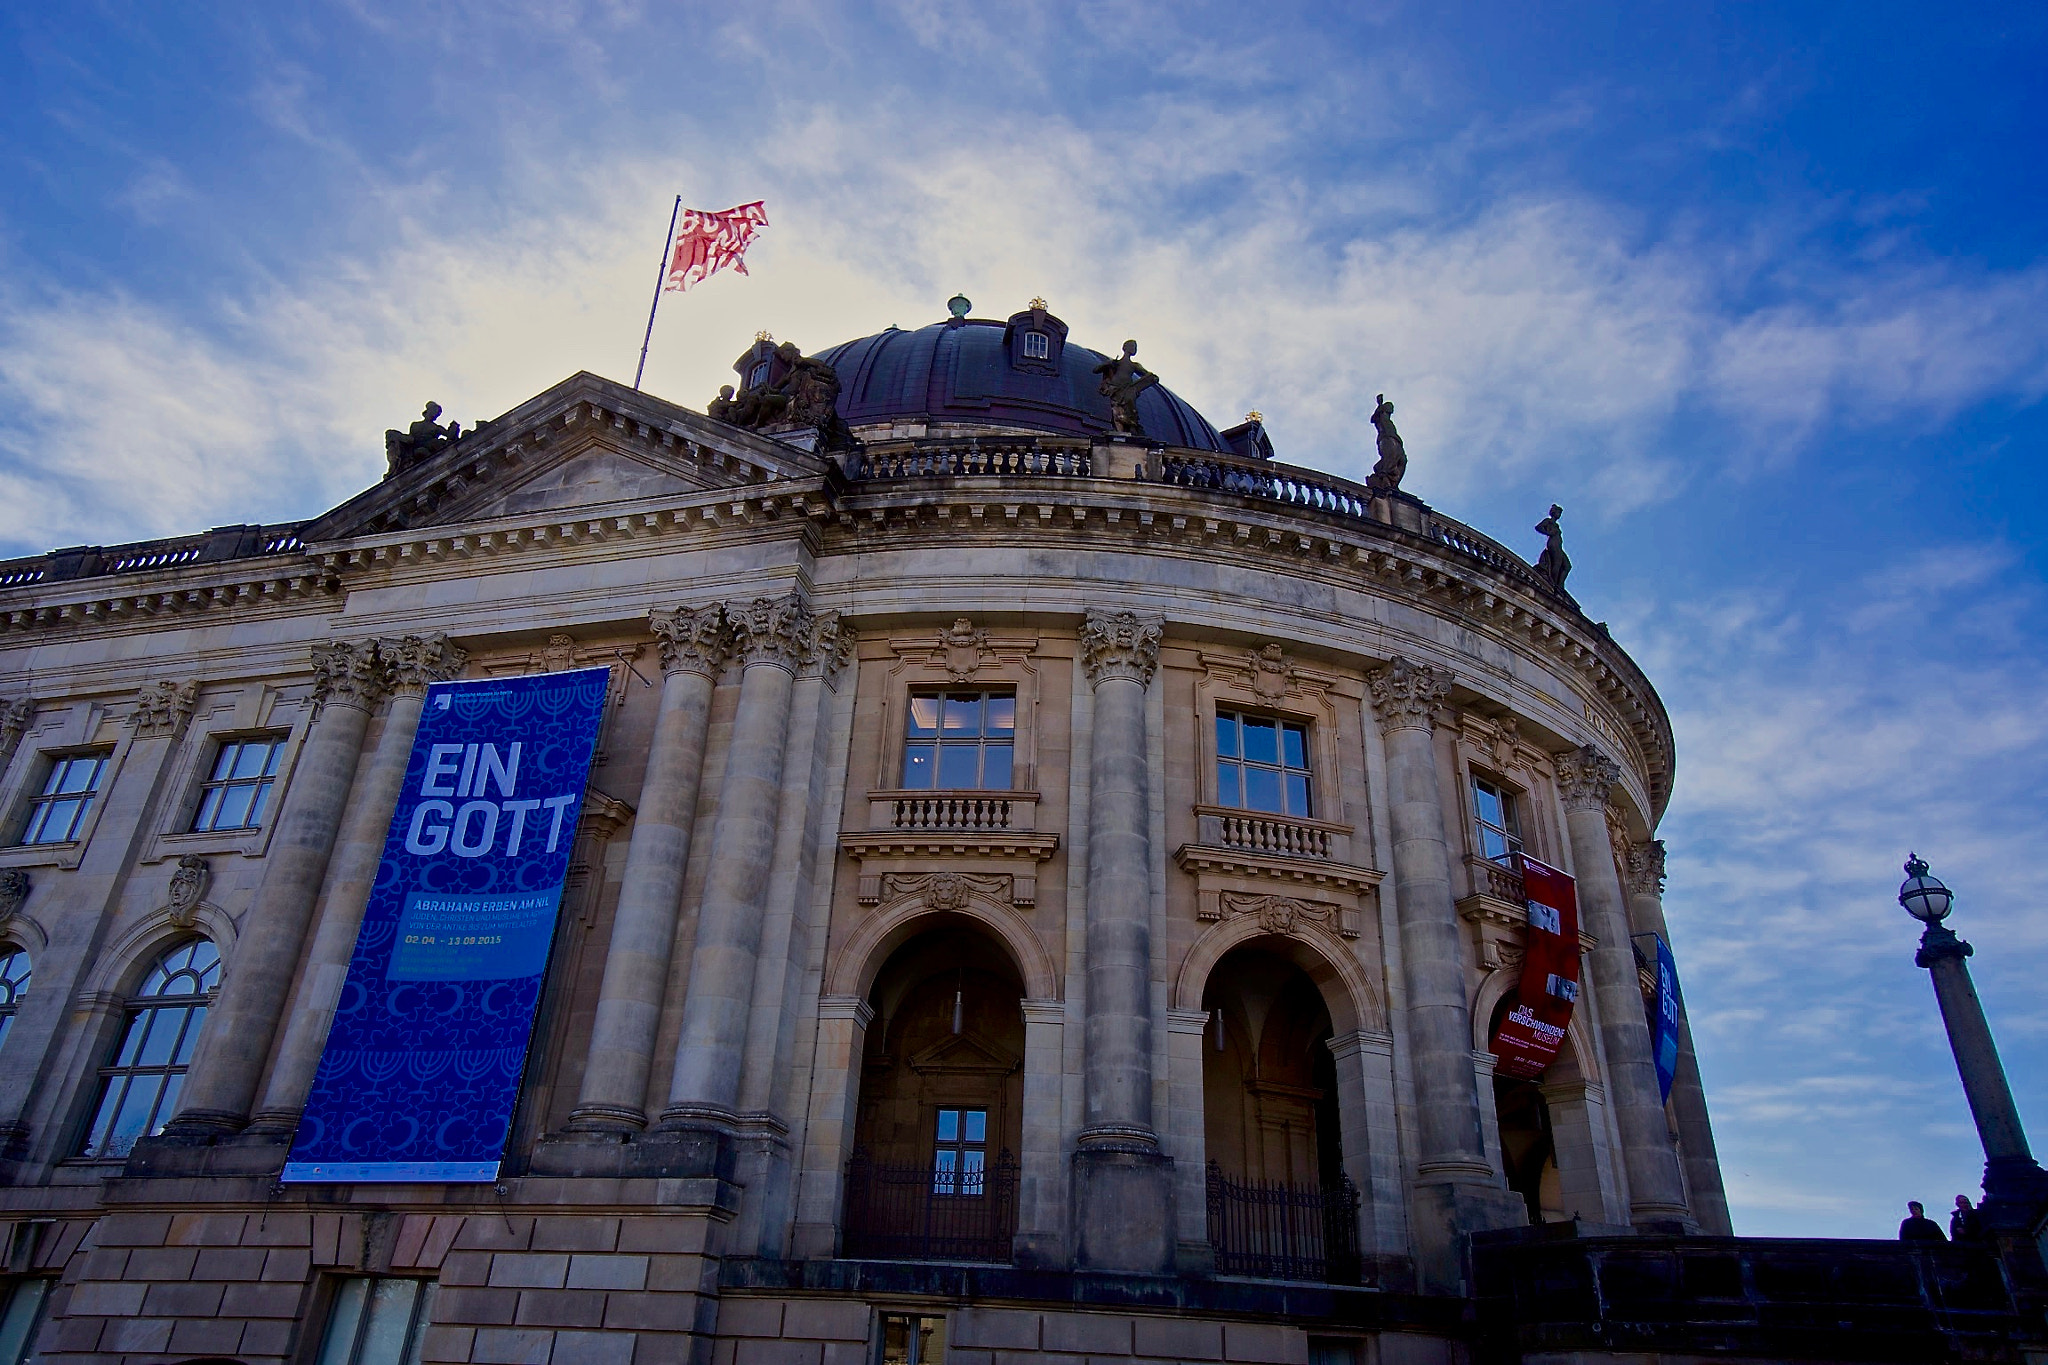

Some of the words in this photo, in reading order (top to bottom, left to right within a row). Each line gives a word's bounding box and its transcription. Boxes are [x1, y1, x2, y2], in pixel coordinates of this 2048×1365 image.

[420, 742, 521, 797] EIN
[405, 793, 576, 858] GOTT
[413, 899, 480, 913] ABRAHAMS
[482, 900, 517, 912] ERBEN
[518, 899, 535, 910] AM
[535, 896, 549, 908] NIL
[409, 921, 425, 930] VON
[425, 922, 442, 931] DER
[443, 922, 468, 932] ANTIKE
[468, 923, 480, 931] BIS
[480, 922, 496, 931] ZUM
[497, 919, 538, 929] MITTELALTER
[439, 913, 475, 923] CHRISTEN
[476, 913, 491, 922] UND
[492, 912, 521, 921] MUSLIME
[1518, 1004, 1534, 1018] DAS
[1508, 1010, 1565, 1038] VERSCHWUNDENE
[1532, 1030, 1561, 1046] MUSEUM
